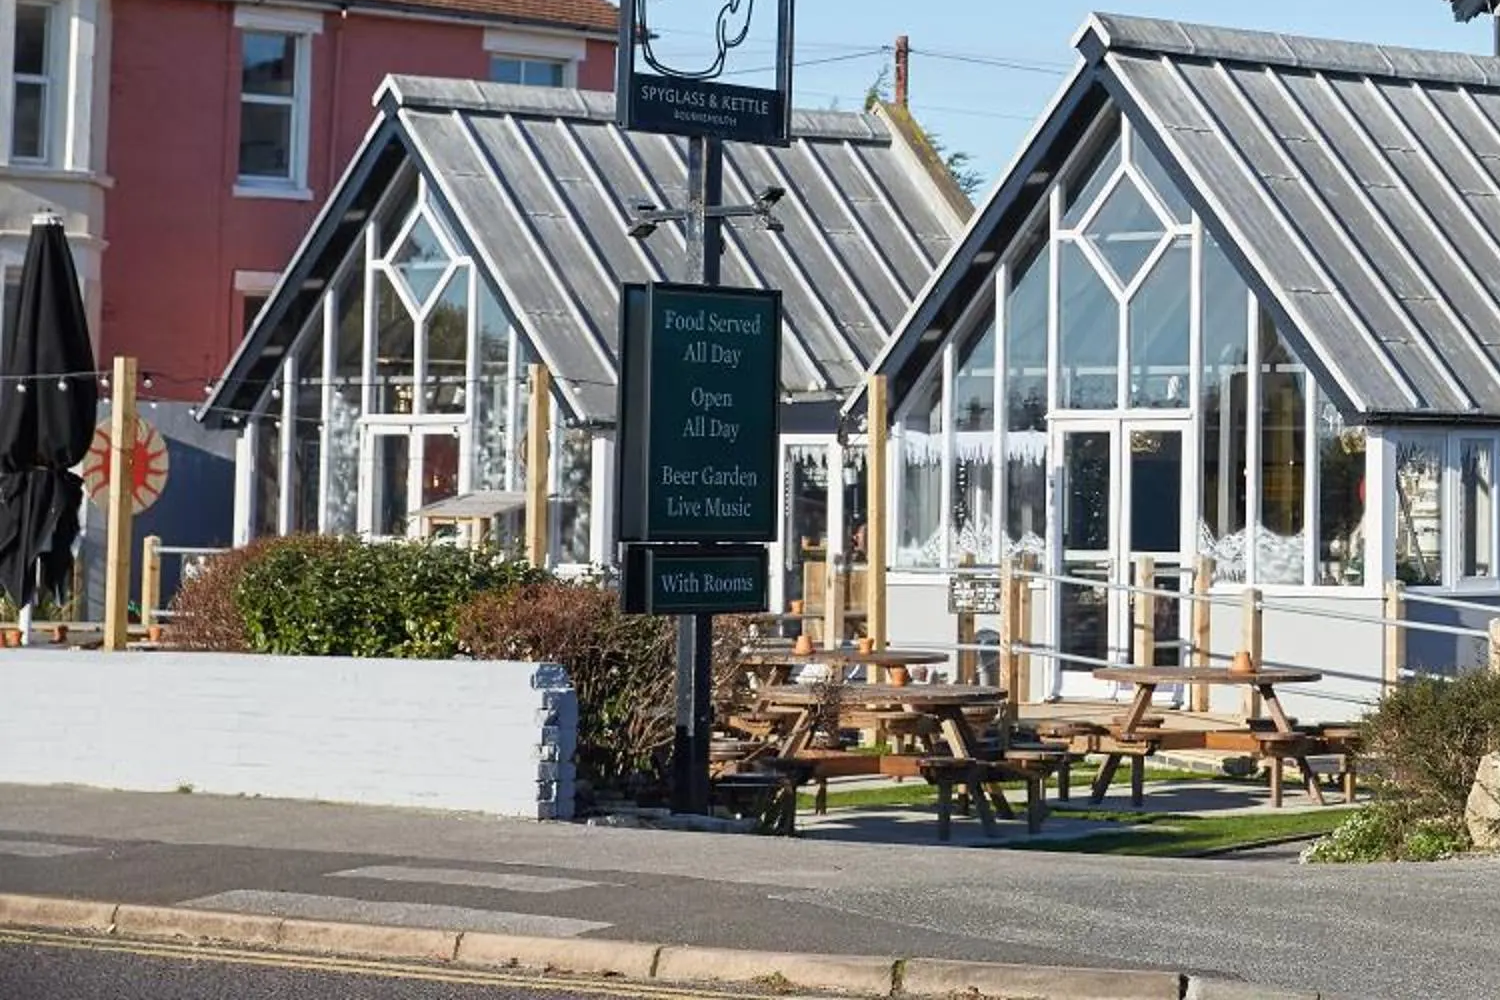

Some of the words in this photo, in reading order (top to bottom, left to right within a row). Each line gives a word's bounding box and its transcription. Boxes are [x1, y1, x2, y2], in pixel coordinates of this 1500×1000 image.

[641, 85, 705, 107] SPYGLASS
[709, 93, 718, 109] &
[721, 95, 769, 115] KETTLE
[664, 310, 705, 332] Food
[708, 312, 761, 335] Served
[683, 342, 707, 363] All
[711, 344, 741, 369] Day
[691, 386, 732, 411] Open
[682, 416, 706, 438] All
[709, 418, 740, 444] Day
[661, 465, 698, 486] Beer
[701, 465, 757, 487] Garden
[667, 496, 701, 517] Live
[704, 497, 751, 517] Music
[661, 571, 699, 593] With
[703, 573, 753, 593] Rooms
